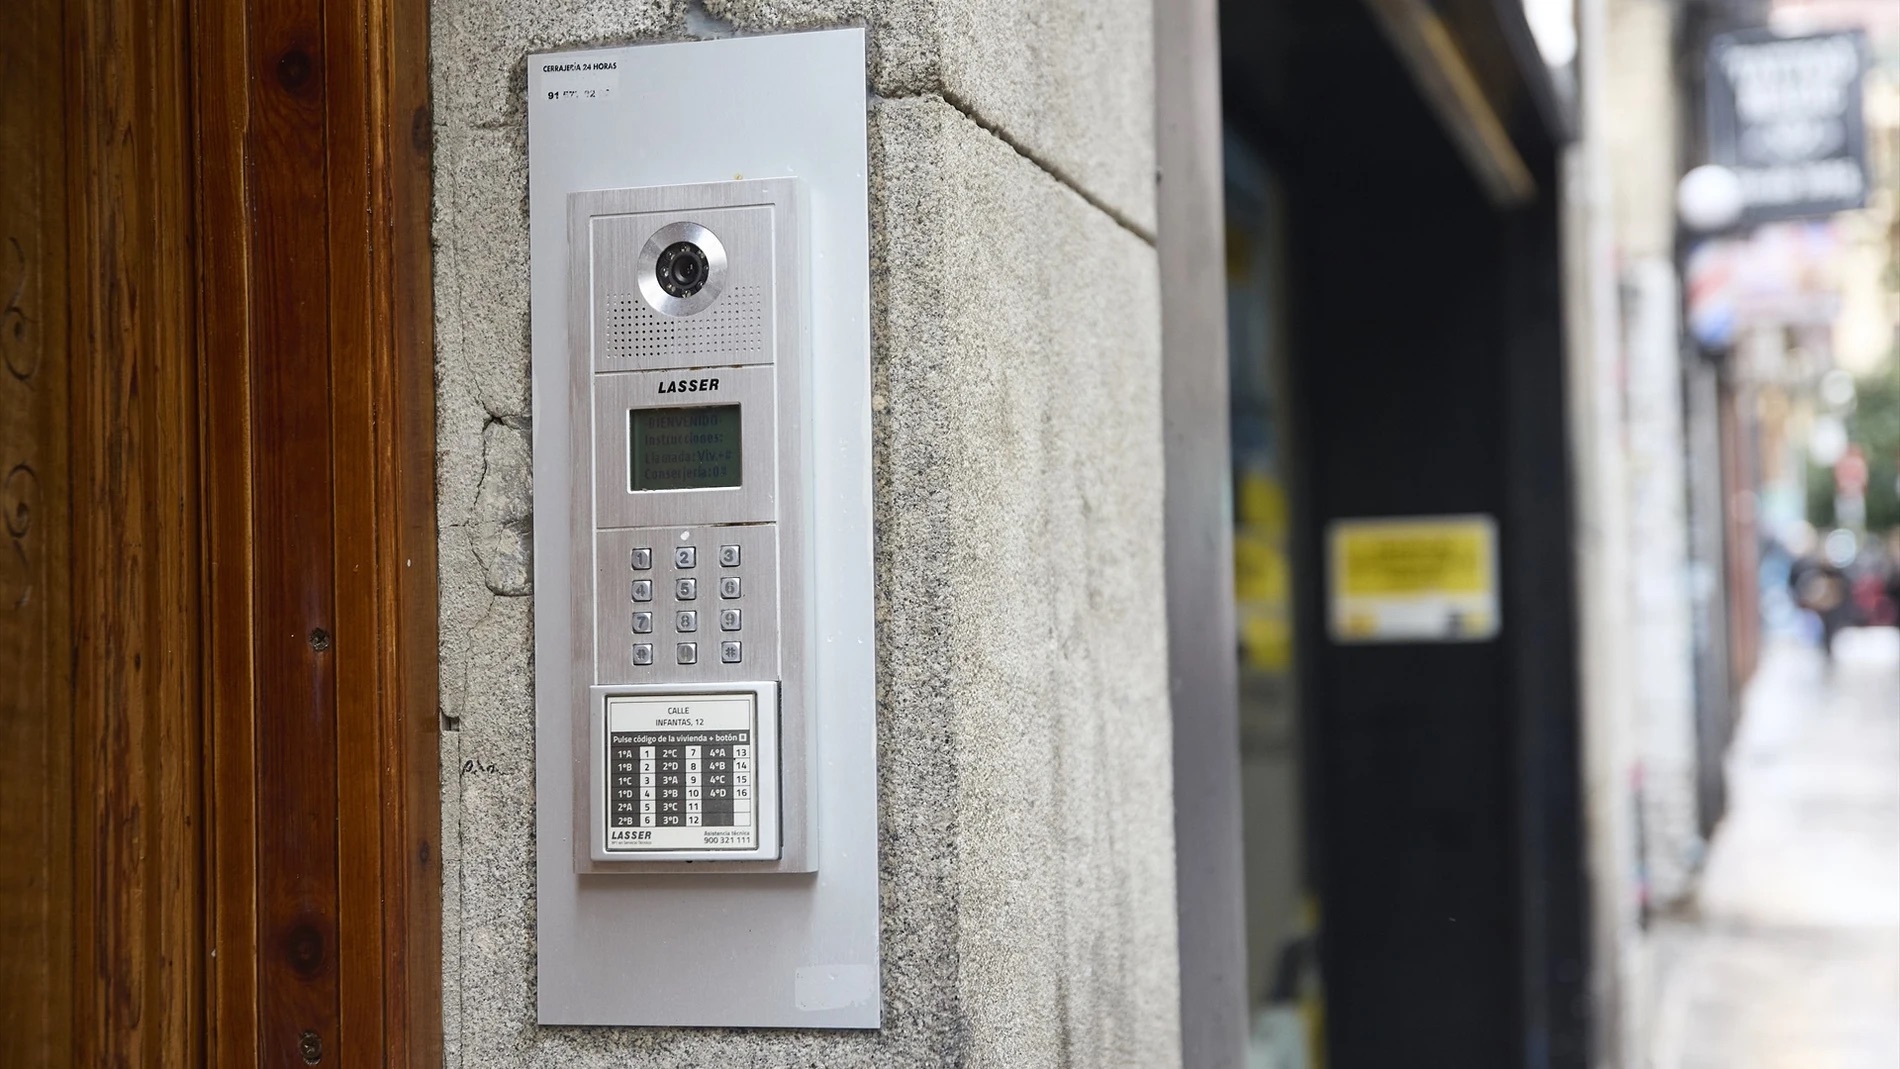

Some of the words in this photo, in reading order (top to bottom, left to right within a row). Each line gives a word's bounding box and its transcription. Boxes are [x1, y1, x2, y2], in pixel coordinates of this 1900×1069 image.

[593, 62, 617, 70] HORAS
[547, 91, 559, 100] 91
[658, 378, 719, 394] LASSER
[680, 551, 689, 563] 2
[724, 549, 734, 562] 3
[635, 585, 645, 597] 4
[680, 583, 689, 595] 5
[725, 581, 735, 594] 6
[637, 616, 647, 629] 7
[681, 615, 690, 628] 8
[725, 613, 735, 626] 9
[668, 707, 690, 715] CALLE
[655, 719, 693, 727] INFANTAS,
[695, 718, 704, 726] 12
[633, 734, 656, 745] código
[658, 735, 667, 743] de
[676, 734, 707, 742] vivienda
[715, 733, 737, 741] botón
[691, 776, 696, 784] 9
[644, 790, 650, 798] 4
[688, 789, 699, 797] 10
[689, 816, 699, 824] 12
[611, 831, 652, 839] LASSER
